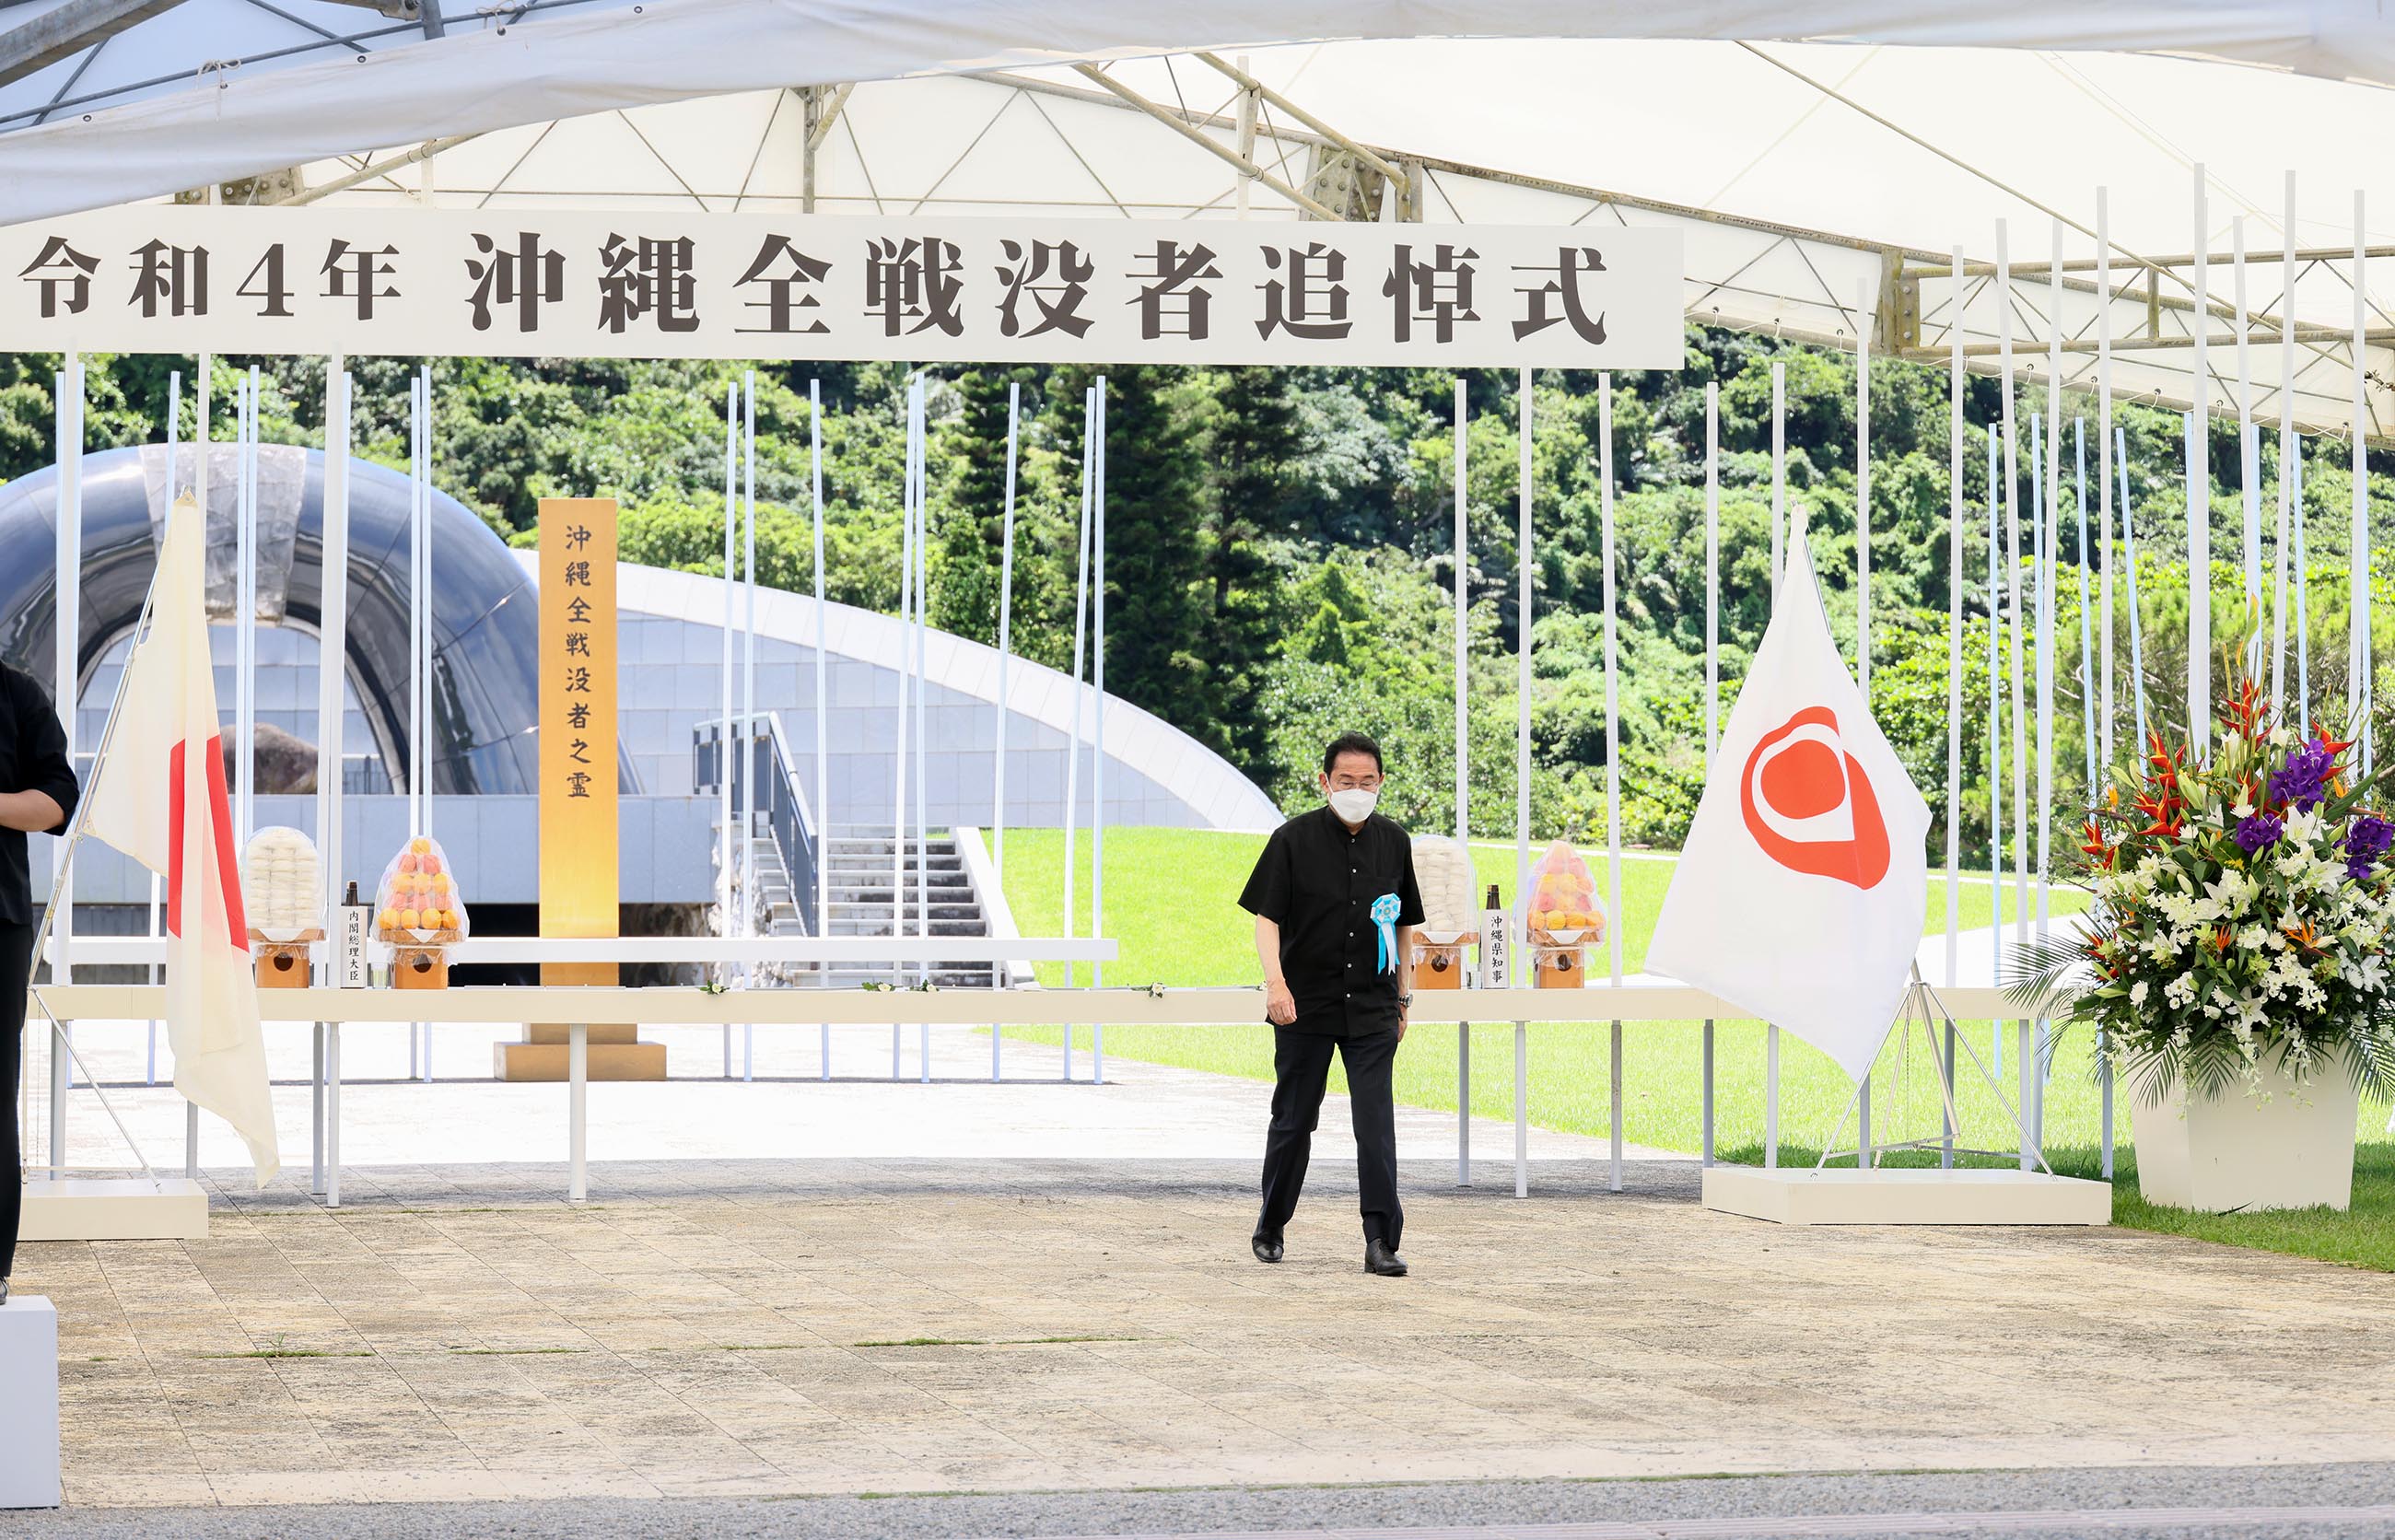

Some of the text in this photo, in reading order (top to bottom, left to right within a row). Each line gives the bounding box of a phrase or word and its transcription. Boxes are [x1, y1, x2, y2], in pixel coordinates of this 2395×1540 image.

[18, 231, 1608, 345] 令和4年 沖縄全戦没者追悼式
[565, 524, 592, 798] 沖縄全戦没者之霊
[348, 910, 360, 981] 内閣総理大臣
[1490, 916, 1503, 984] 沖縄県知事
